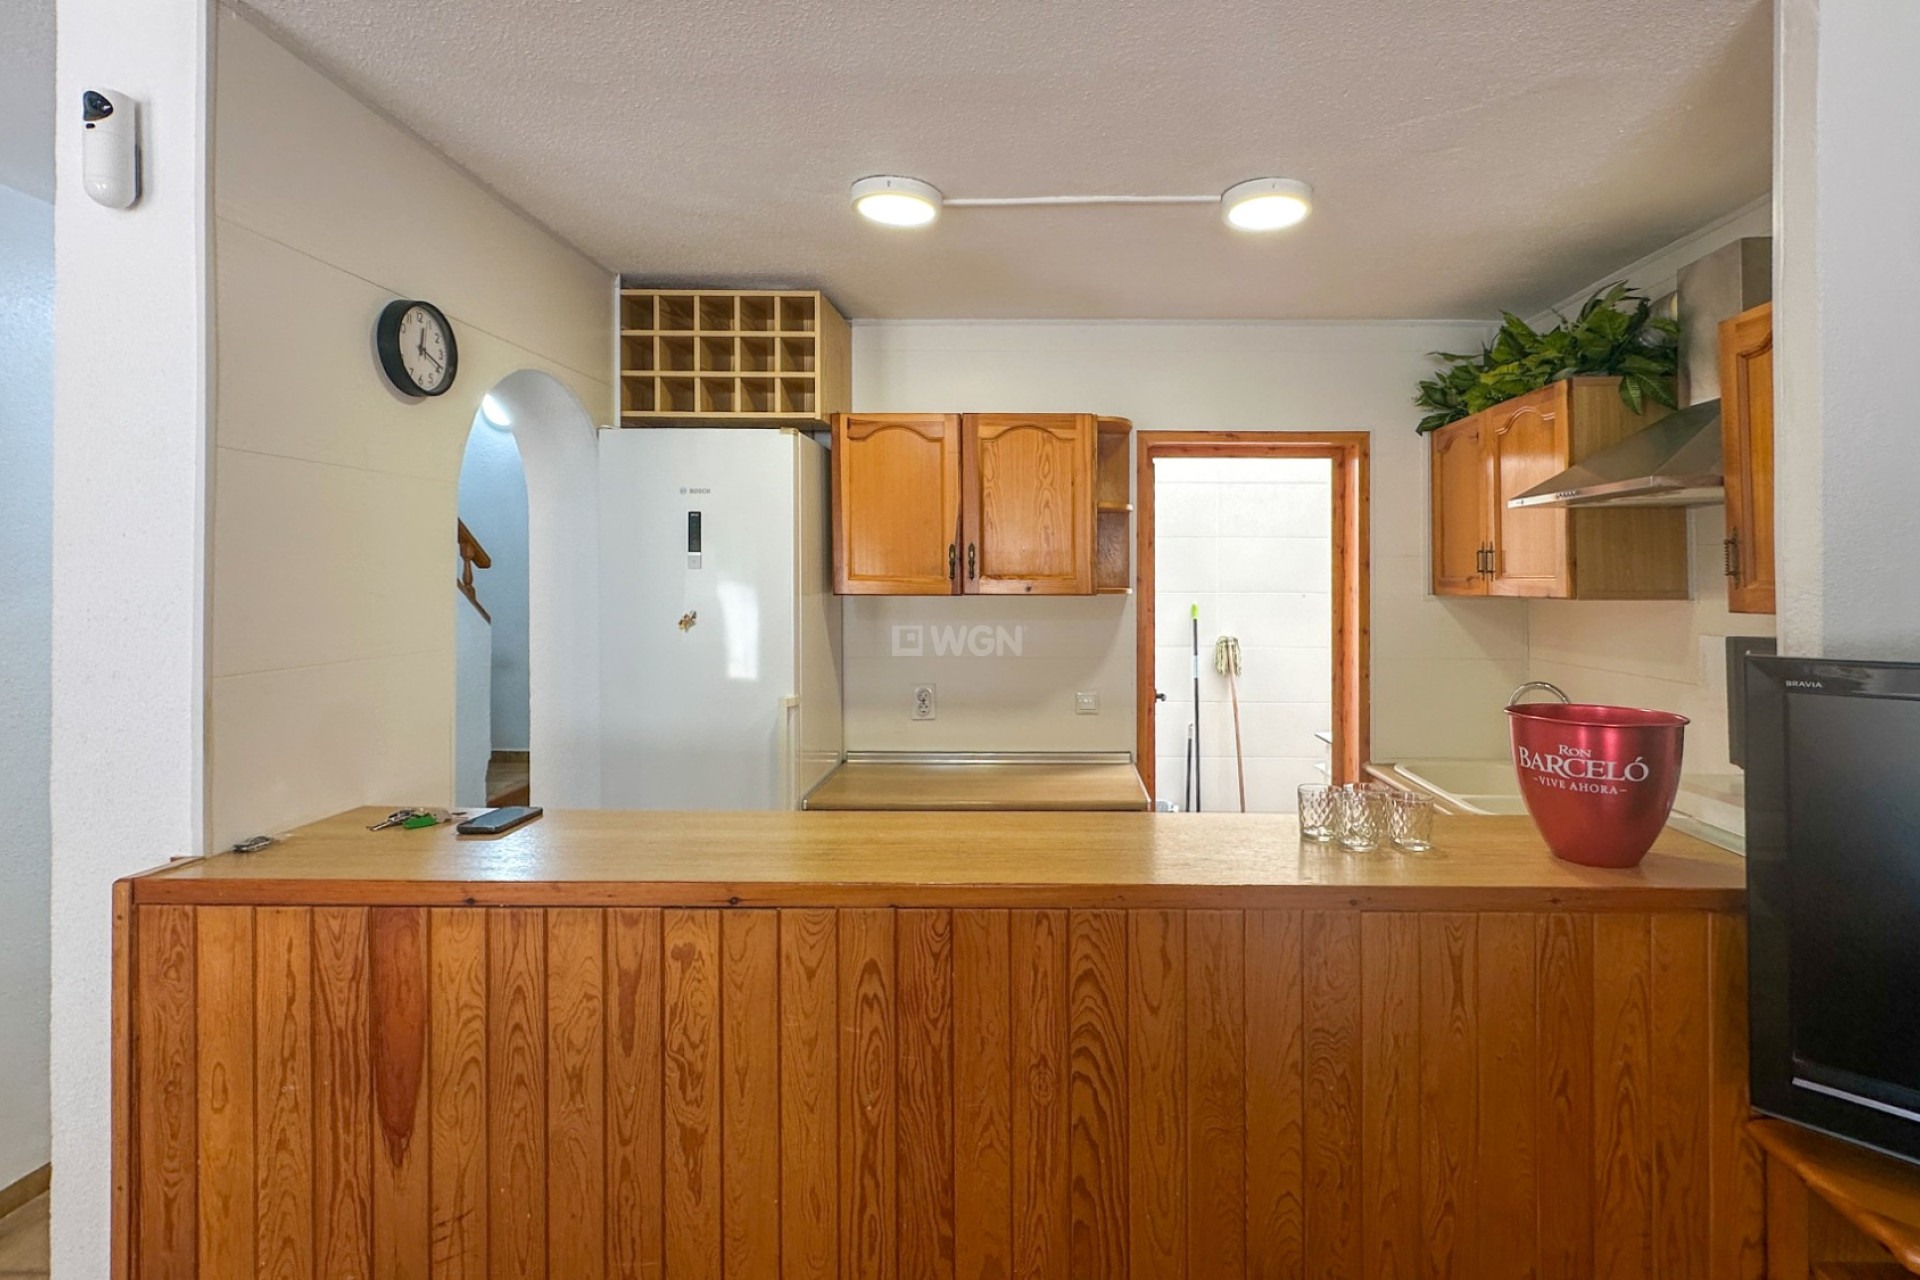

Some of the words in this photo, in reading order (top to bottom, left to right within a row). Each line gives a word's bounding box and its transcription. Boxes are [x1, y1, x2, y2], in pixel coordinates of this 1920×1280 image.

[416, 312, 424, 324] 12
[434, 332, 440, 344] 2
[438, 348, 444, 360] 3
[418, 375, 424, 386] 6
[428, 373, 434, 385] 5
[689, 487, 711, 495] BOSCH
[1785, 679, 1823, 688] BRAVIA
[1518, 745, 1650, 783] BARCELÓ
